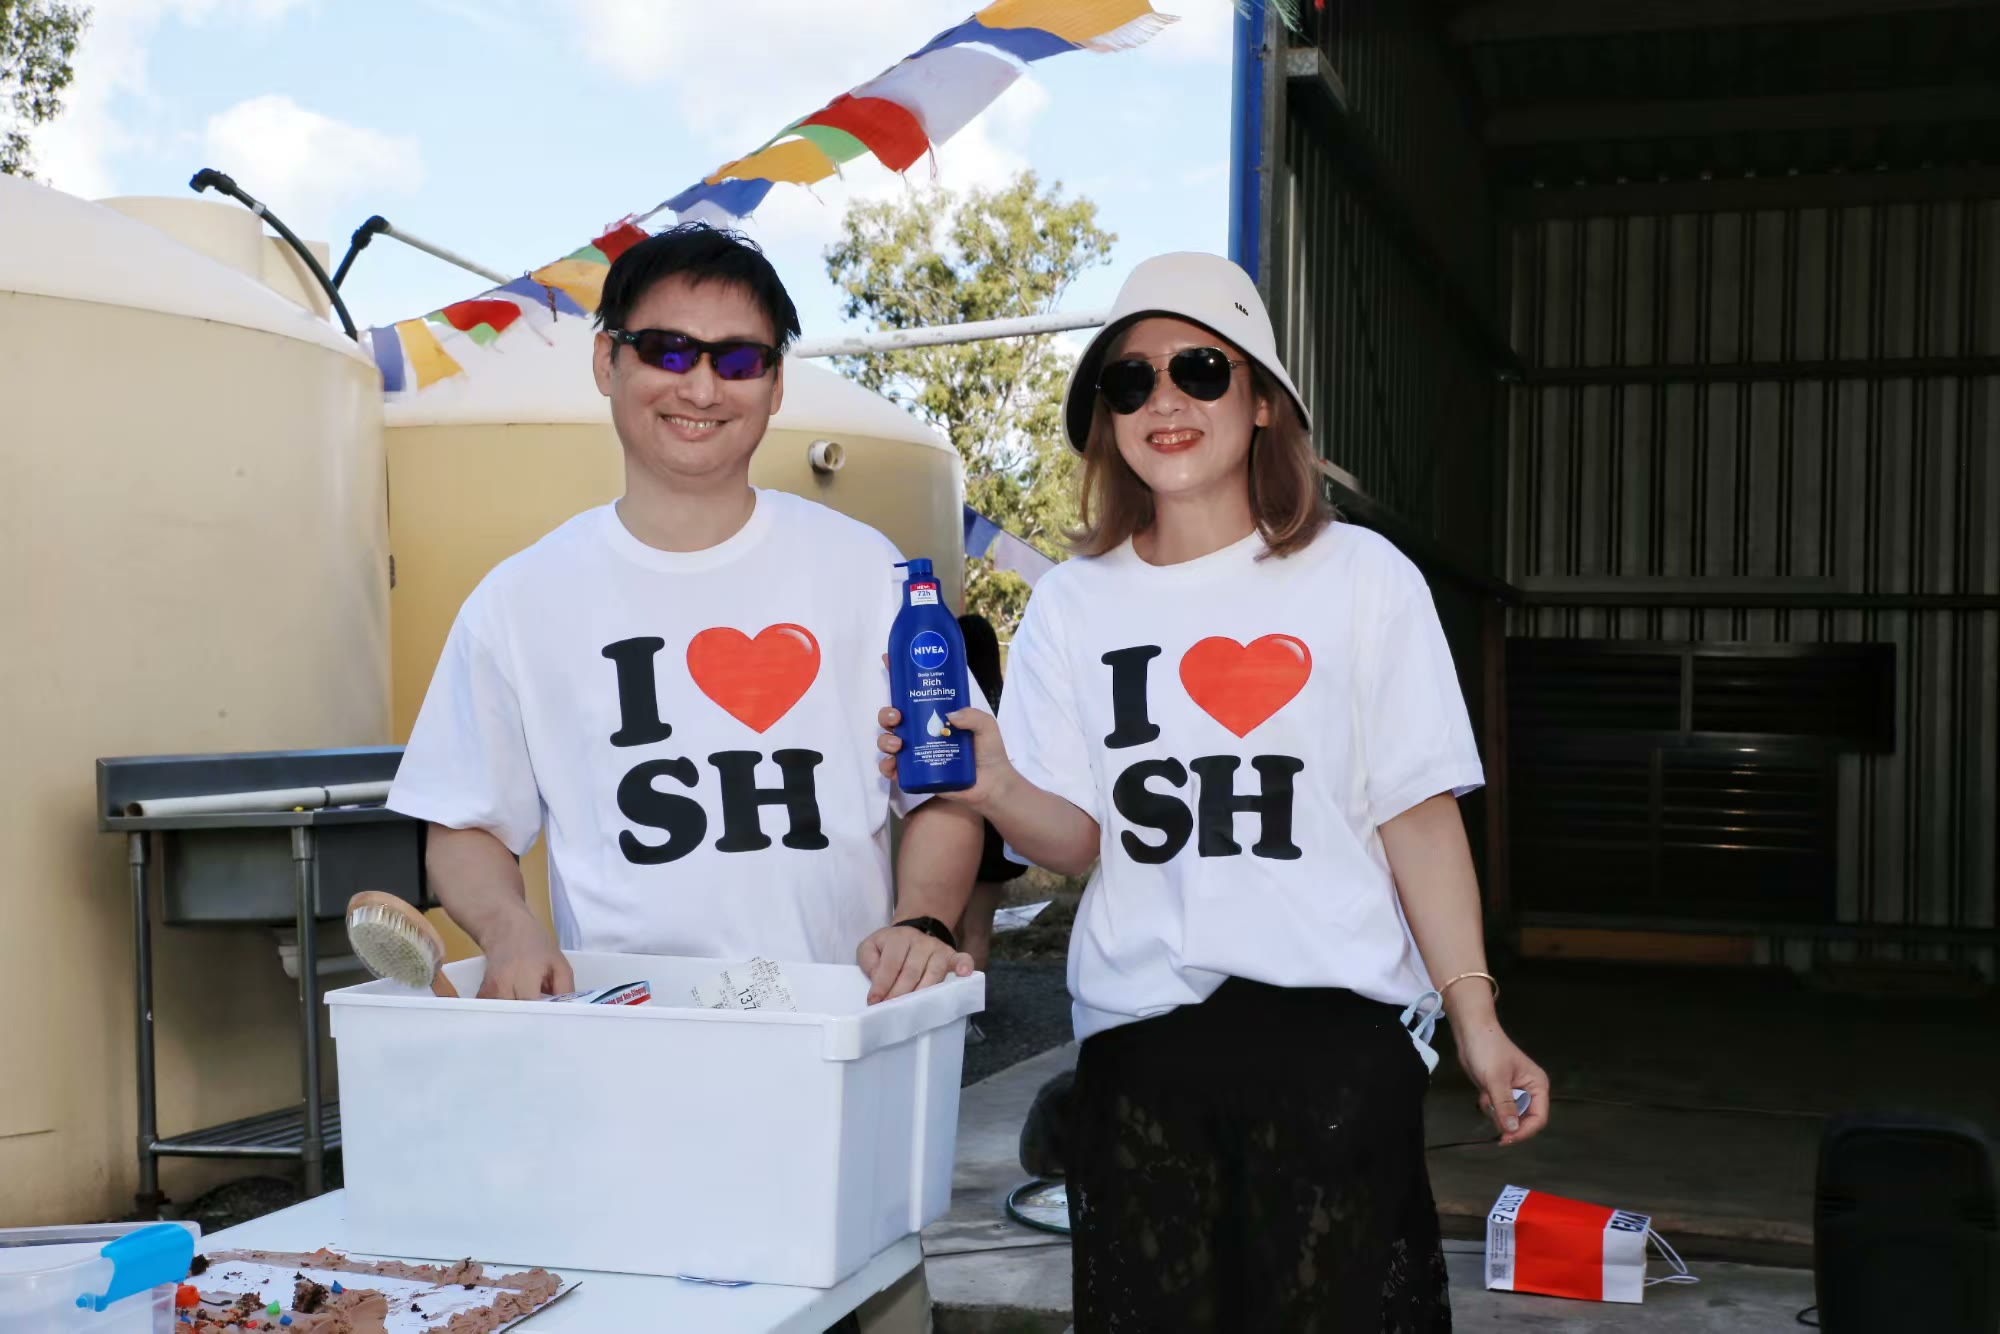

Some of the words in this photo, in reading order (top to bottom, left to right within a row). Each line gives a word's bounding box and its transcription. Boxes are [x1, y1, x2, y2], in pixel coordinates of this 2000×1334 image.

[914, 646, 944, 655] NIVEA
[601, 636, 672, 748] I
[909, 687, 956, 698] Nourishing
[922, 678, 942, 687] Rich
[1100, 644, 1162, 749] I
[616, 748, 829, 865] SH
[1112, 754, 1304, 864] SH
[738, 988, 756, 1010] 137
